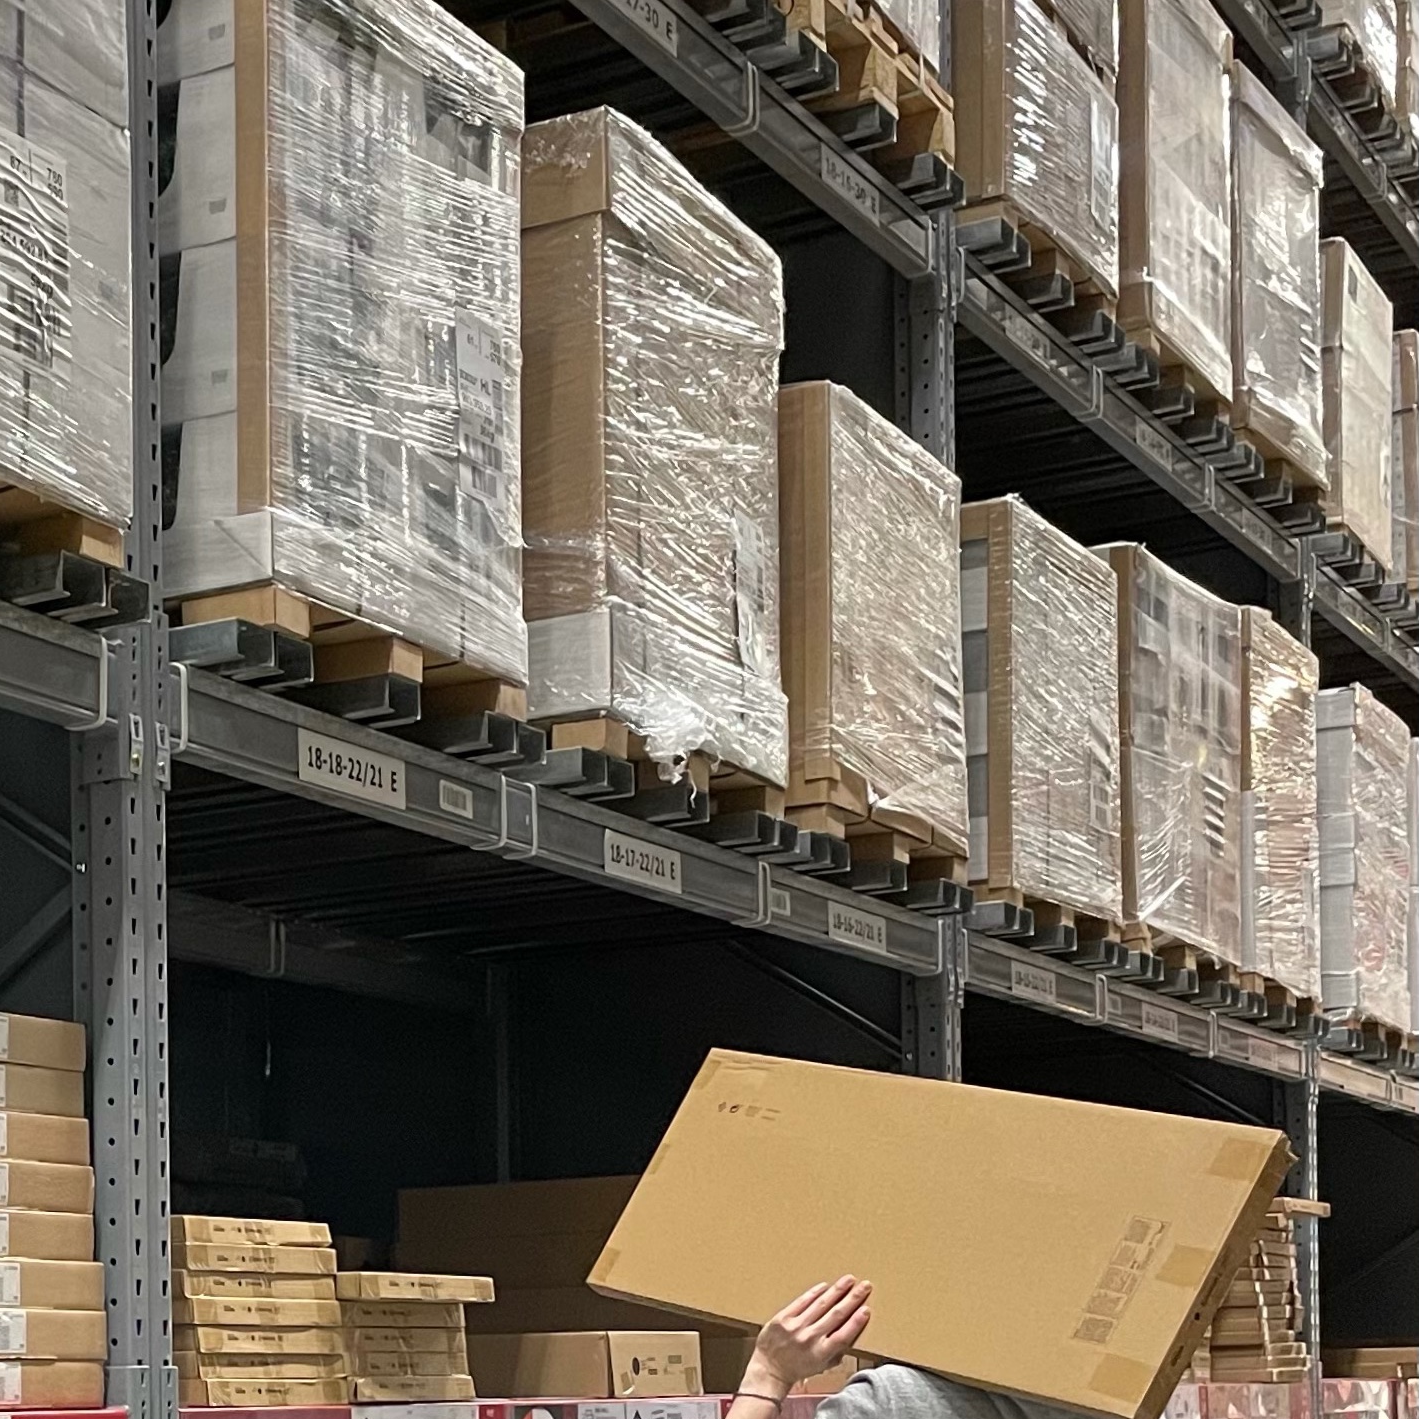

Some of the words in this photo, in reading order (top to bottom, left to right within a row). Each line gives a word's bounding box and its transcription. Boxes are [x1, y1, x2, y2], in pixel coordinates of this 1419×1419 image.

[308, 746, 383, 788] 18-18-22/21
[391, 770, 397, 792] E
[611, 843, 665, 877] 18-17-22/21
[670, 861, 676, 880] E
